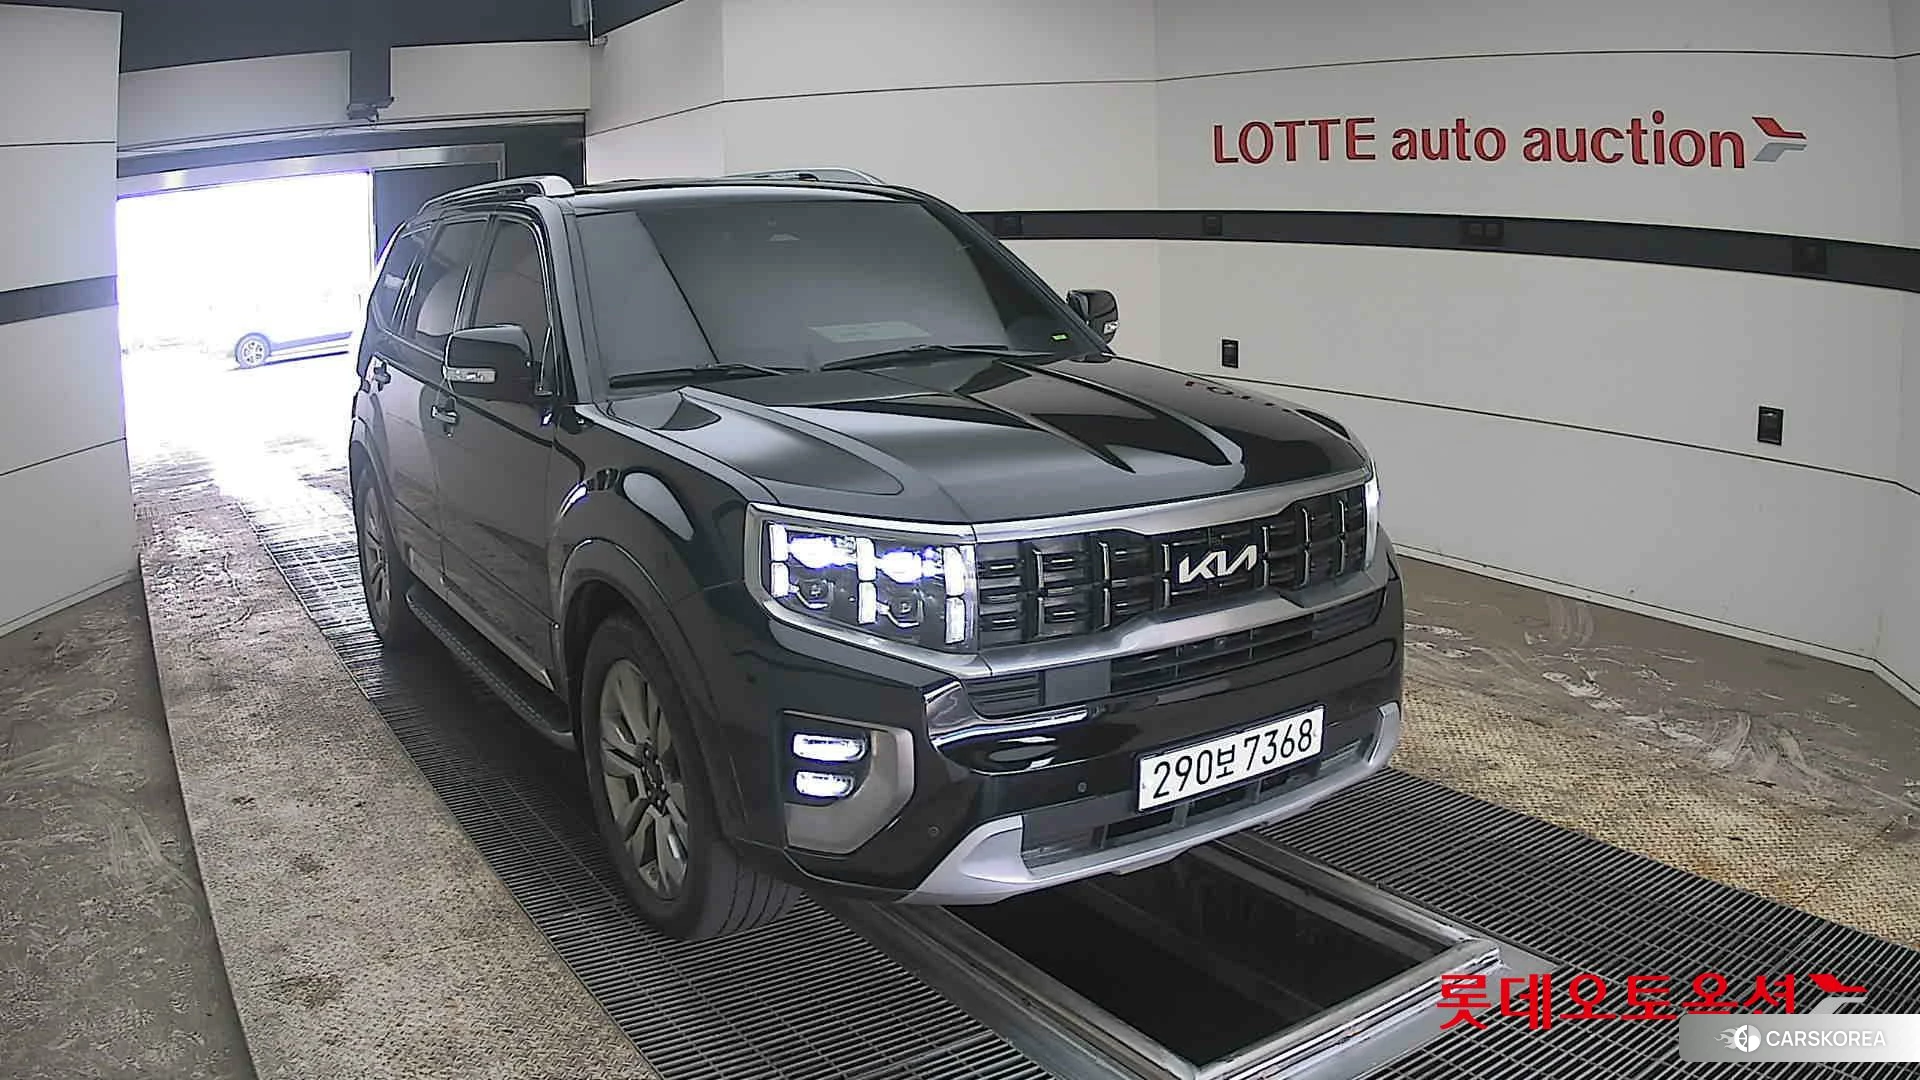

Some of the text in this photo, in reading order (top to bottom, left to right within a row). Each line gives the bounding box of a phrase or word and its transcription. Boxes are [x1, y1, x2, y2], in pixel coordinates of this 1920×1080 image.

[1213, 111, 1746, 168] LOTTE auto auction
[1179, 544, 1257, 584] KIA
